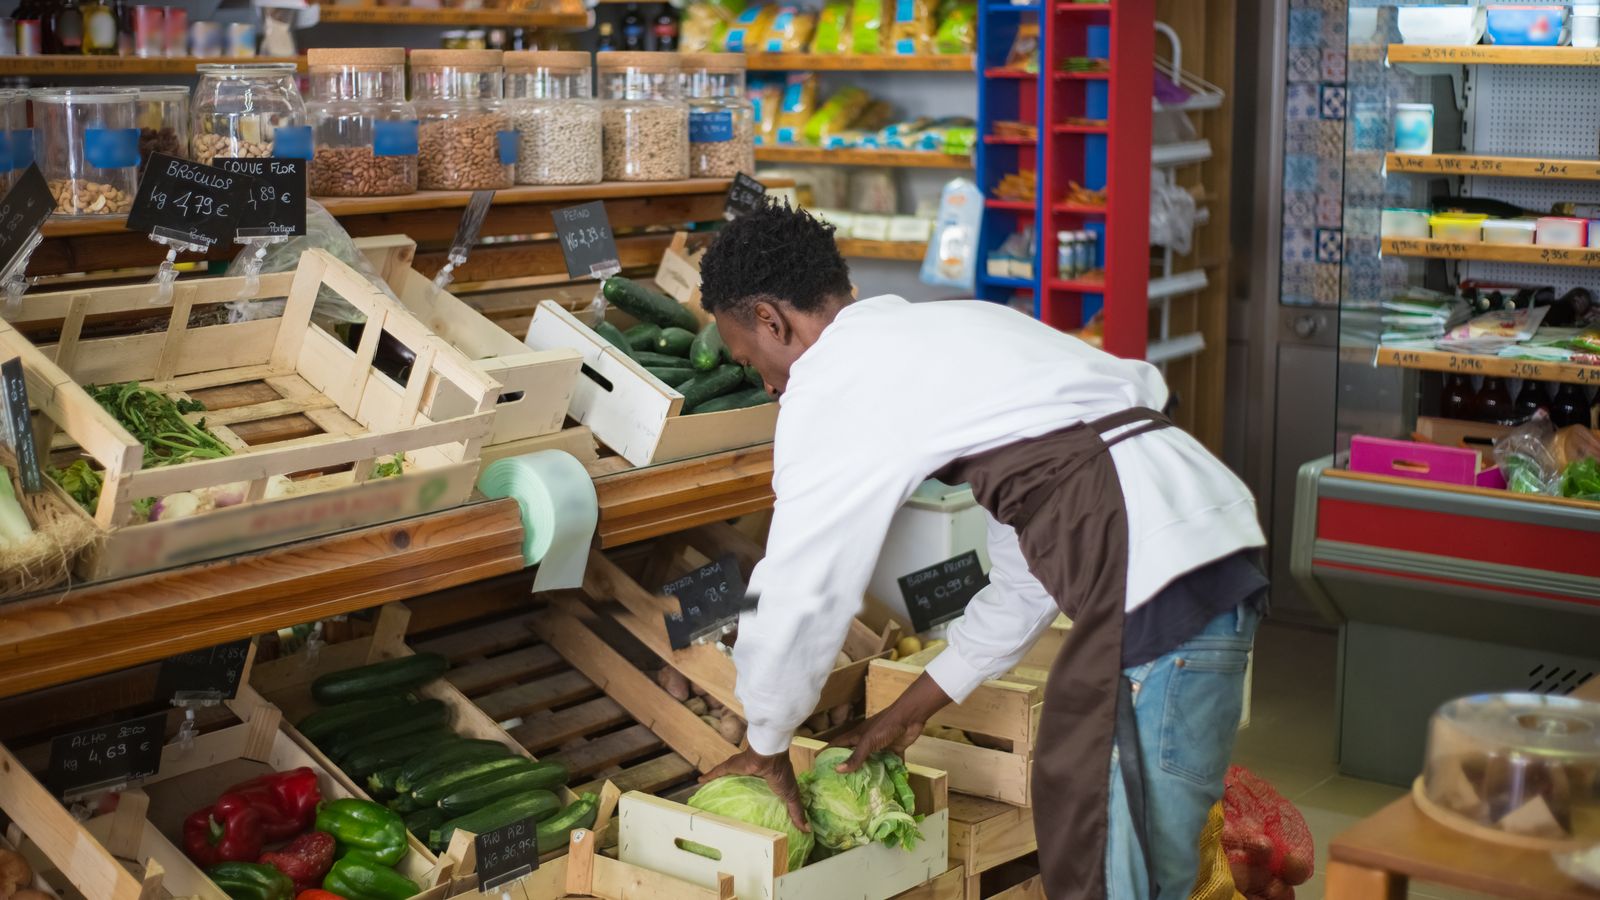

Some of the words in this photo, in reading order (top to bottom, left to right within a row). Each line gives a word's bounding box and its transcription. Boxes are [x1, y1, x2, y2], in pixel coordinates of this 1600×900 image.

[166, 160, 233, 190] BRÓCULOS
[223, 160, 263, 175] COUVE
[270, 162, 296, 175] FLOR
[268, 221, 296, 233] Portugal
[71, 733, 107, 749] ALHO
